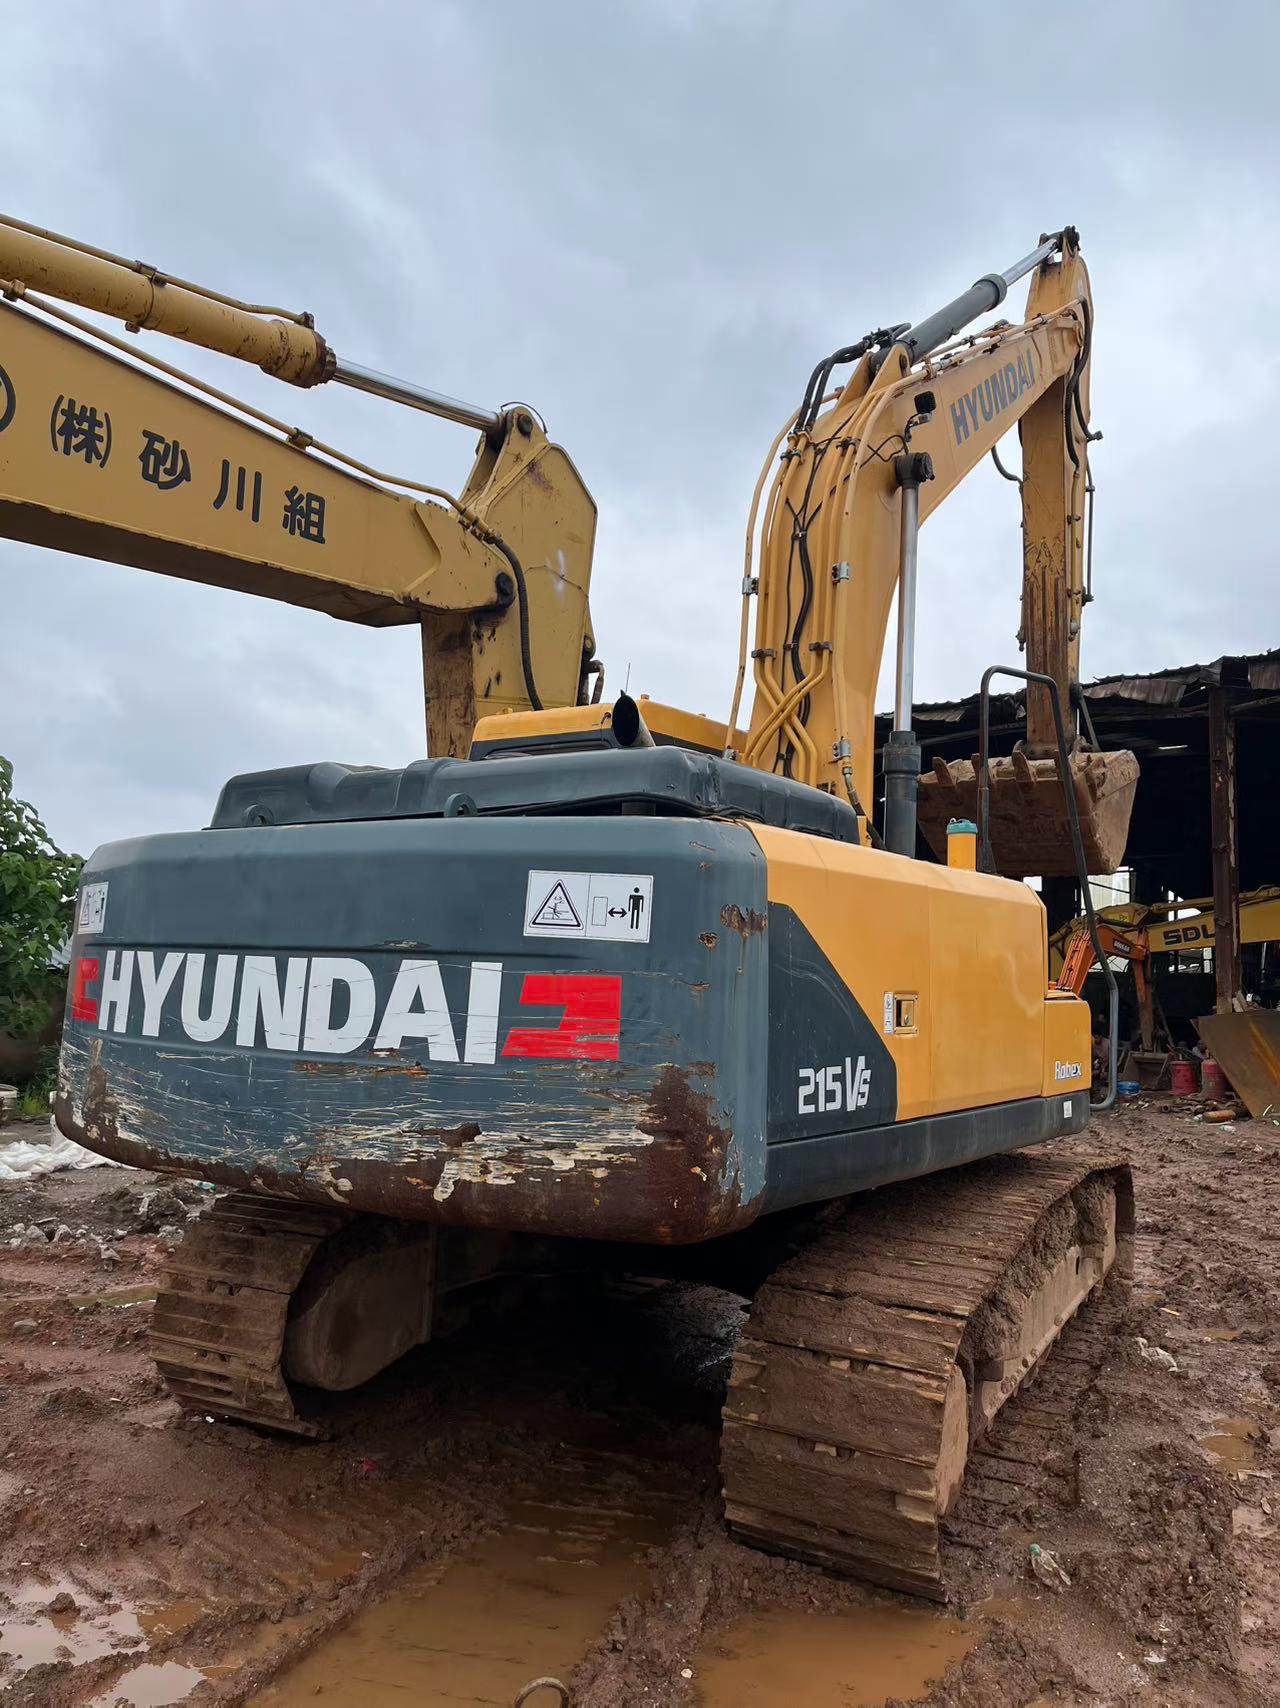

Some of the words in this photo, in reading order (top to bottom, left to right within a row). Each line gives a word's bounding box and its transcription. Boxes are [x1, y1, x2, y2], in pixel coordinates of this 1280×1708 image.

[950, 349, 1035, 446] HYUNDAI
[50, 394, 326, 544] (株)砂川組
[98, 950, 502, 1064] HYUNDAI
[1055, 1060, 1082, 1080] Robex
